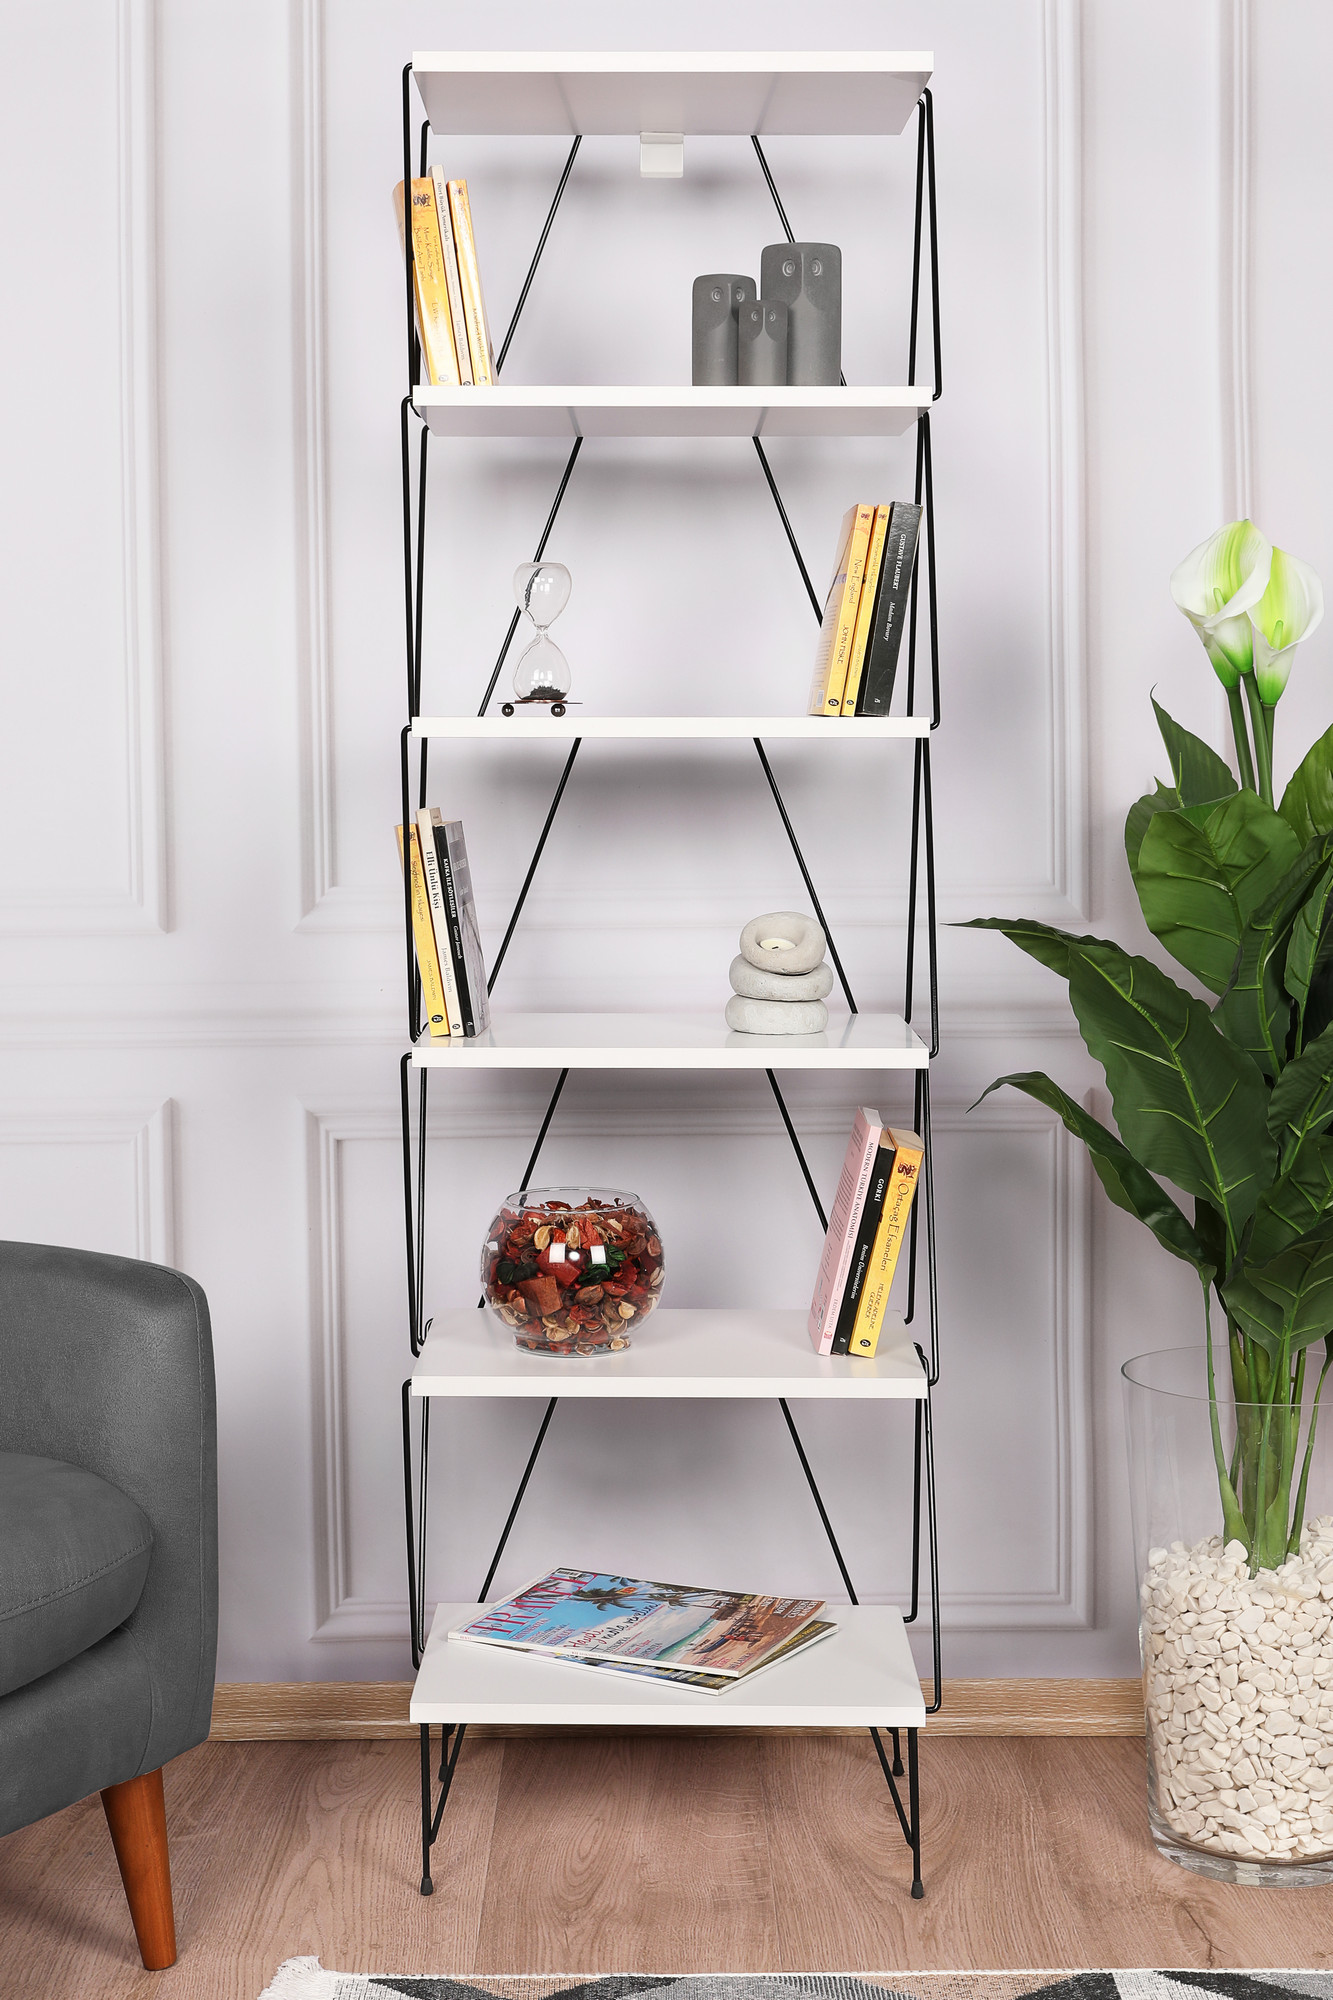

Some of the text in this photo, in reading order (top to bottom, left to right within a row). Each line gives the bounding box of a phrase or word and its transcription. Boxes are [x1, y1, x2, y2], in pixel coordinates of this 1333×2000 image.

[848, 559, 863, 604] New England
[893, 560, 903, 590] FLAUBERT
[837, 625, 849, 664] JOHN FISKE
[883, 622, 892, 641] Bovary
[426, 851, 440, 909] Elli Ünlü Kişi
[848, 1142, 874, 1239] MODERN TÜRKİYE ANATOMİSİ
[874, 1179, 884, 1201] GORKİ
[880, 1183, 909, 1271] Ortaçağ Efsaneleri
[860, 1244, 868, 1260] Benim
[464, 1573, 599, 1634] TRAVEL
